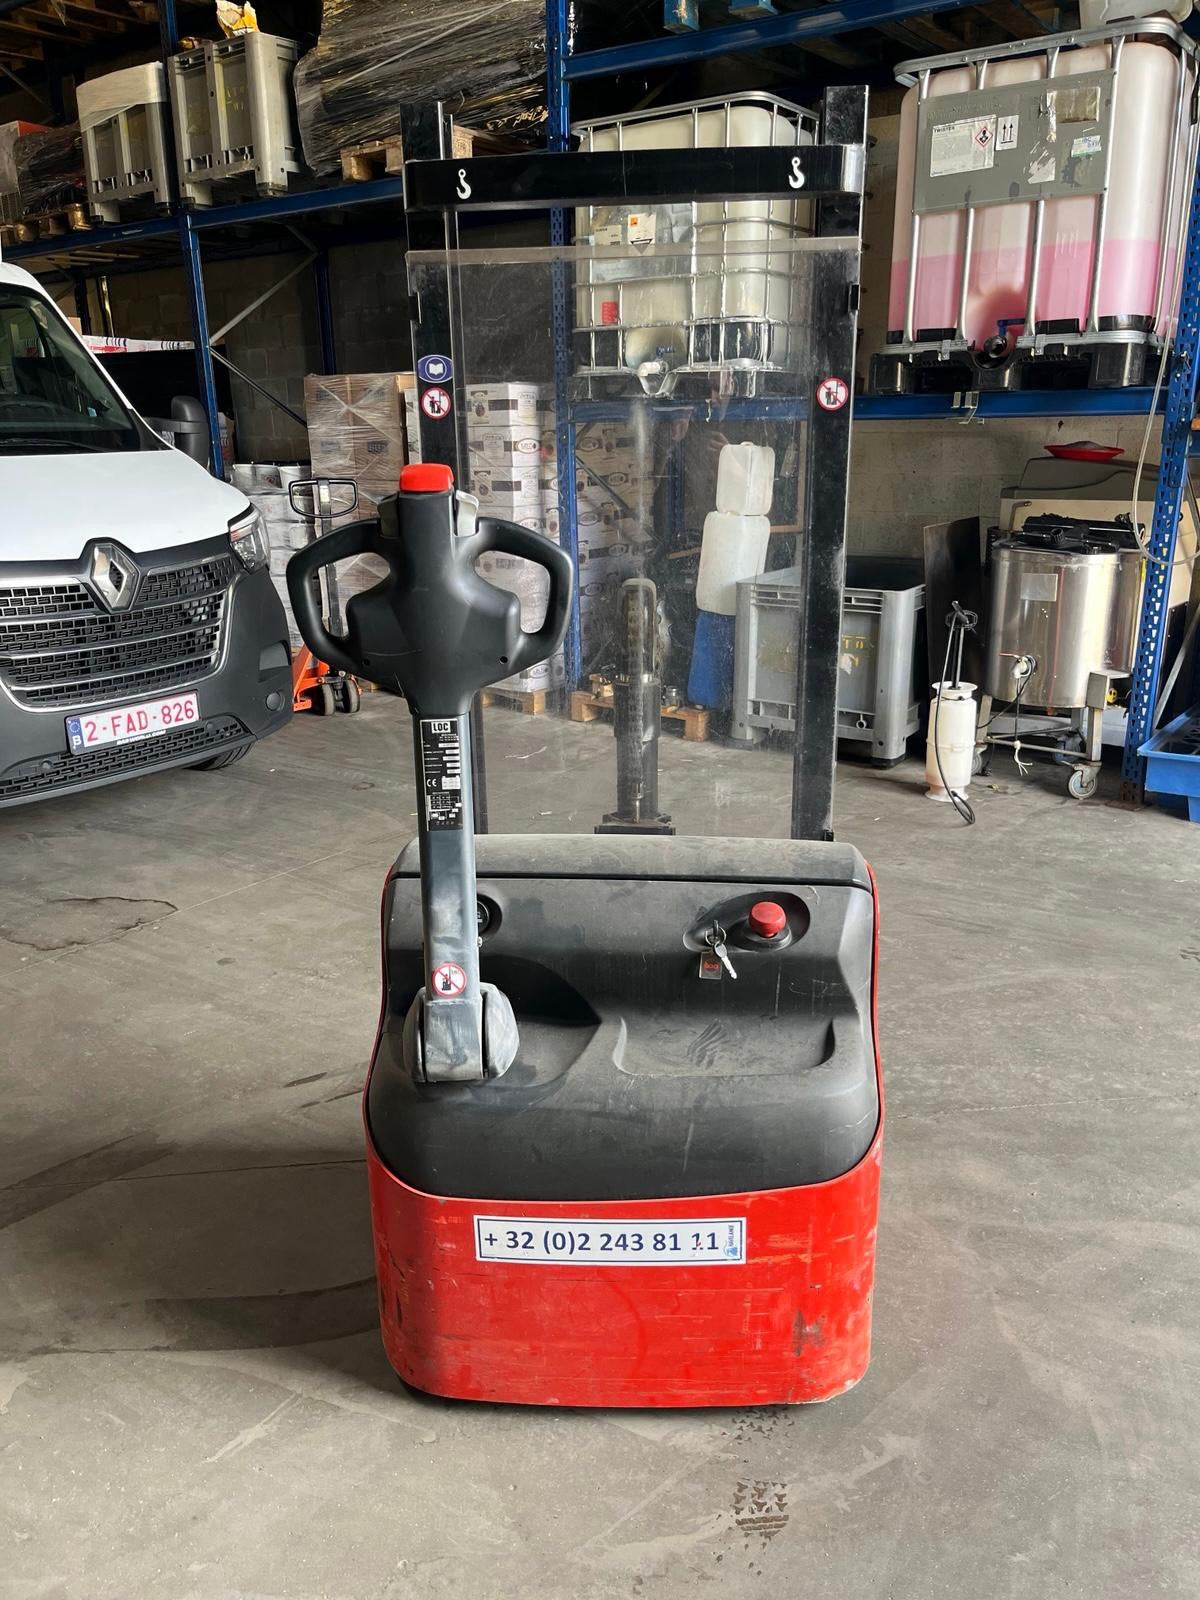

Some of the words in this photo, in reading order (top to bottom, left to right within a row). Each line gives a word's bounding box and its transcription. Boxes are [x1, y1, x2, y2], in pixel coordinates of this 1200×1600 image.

[85, 700, 194, 742] 2-FAD-826
[433, 722, 448, 731] LOC
[72, 735, 82, 746] B
[484, 1232, 498, 1247] +
[506, 1230, 535, 1250] 32
[543, 1230, 591, 1255] (0)2
[599, 1232, 644, 1252] 243
[652, 1232, 682, 1251] 81
[691, 1231, 719, 1251] 11
